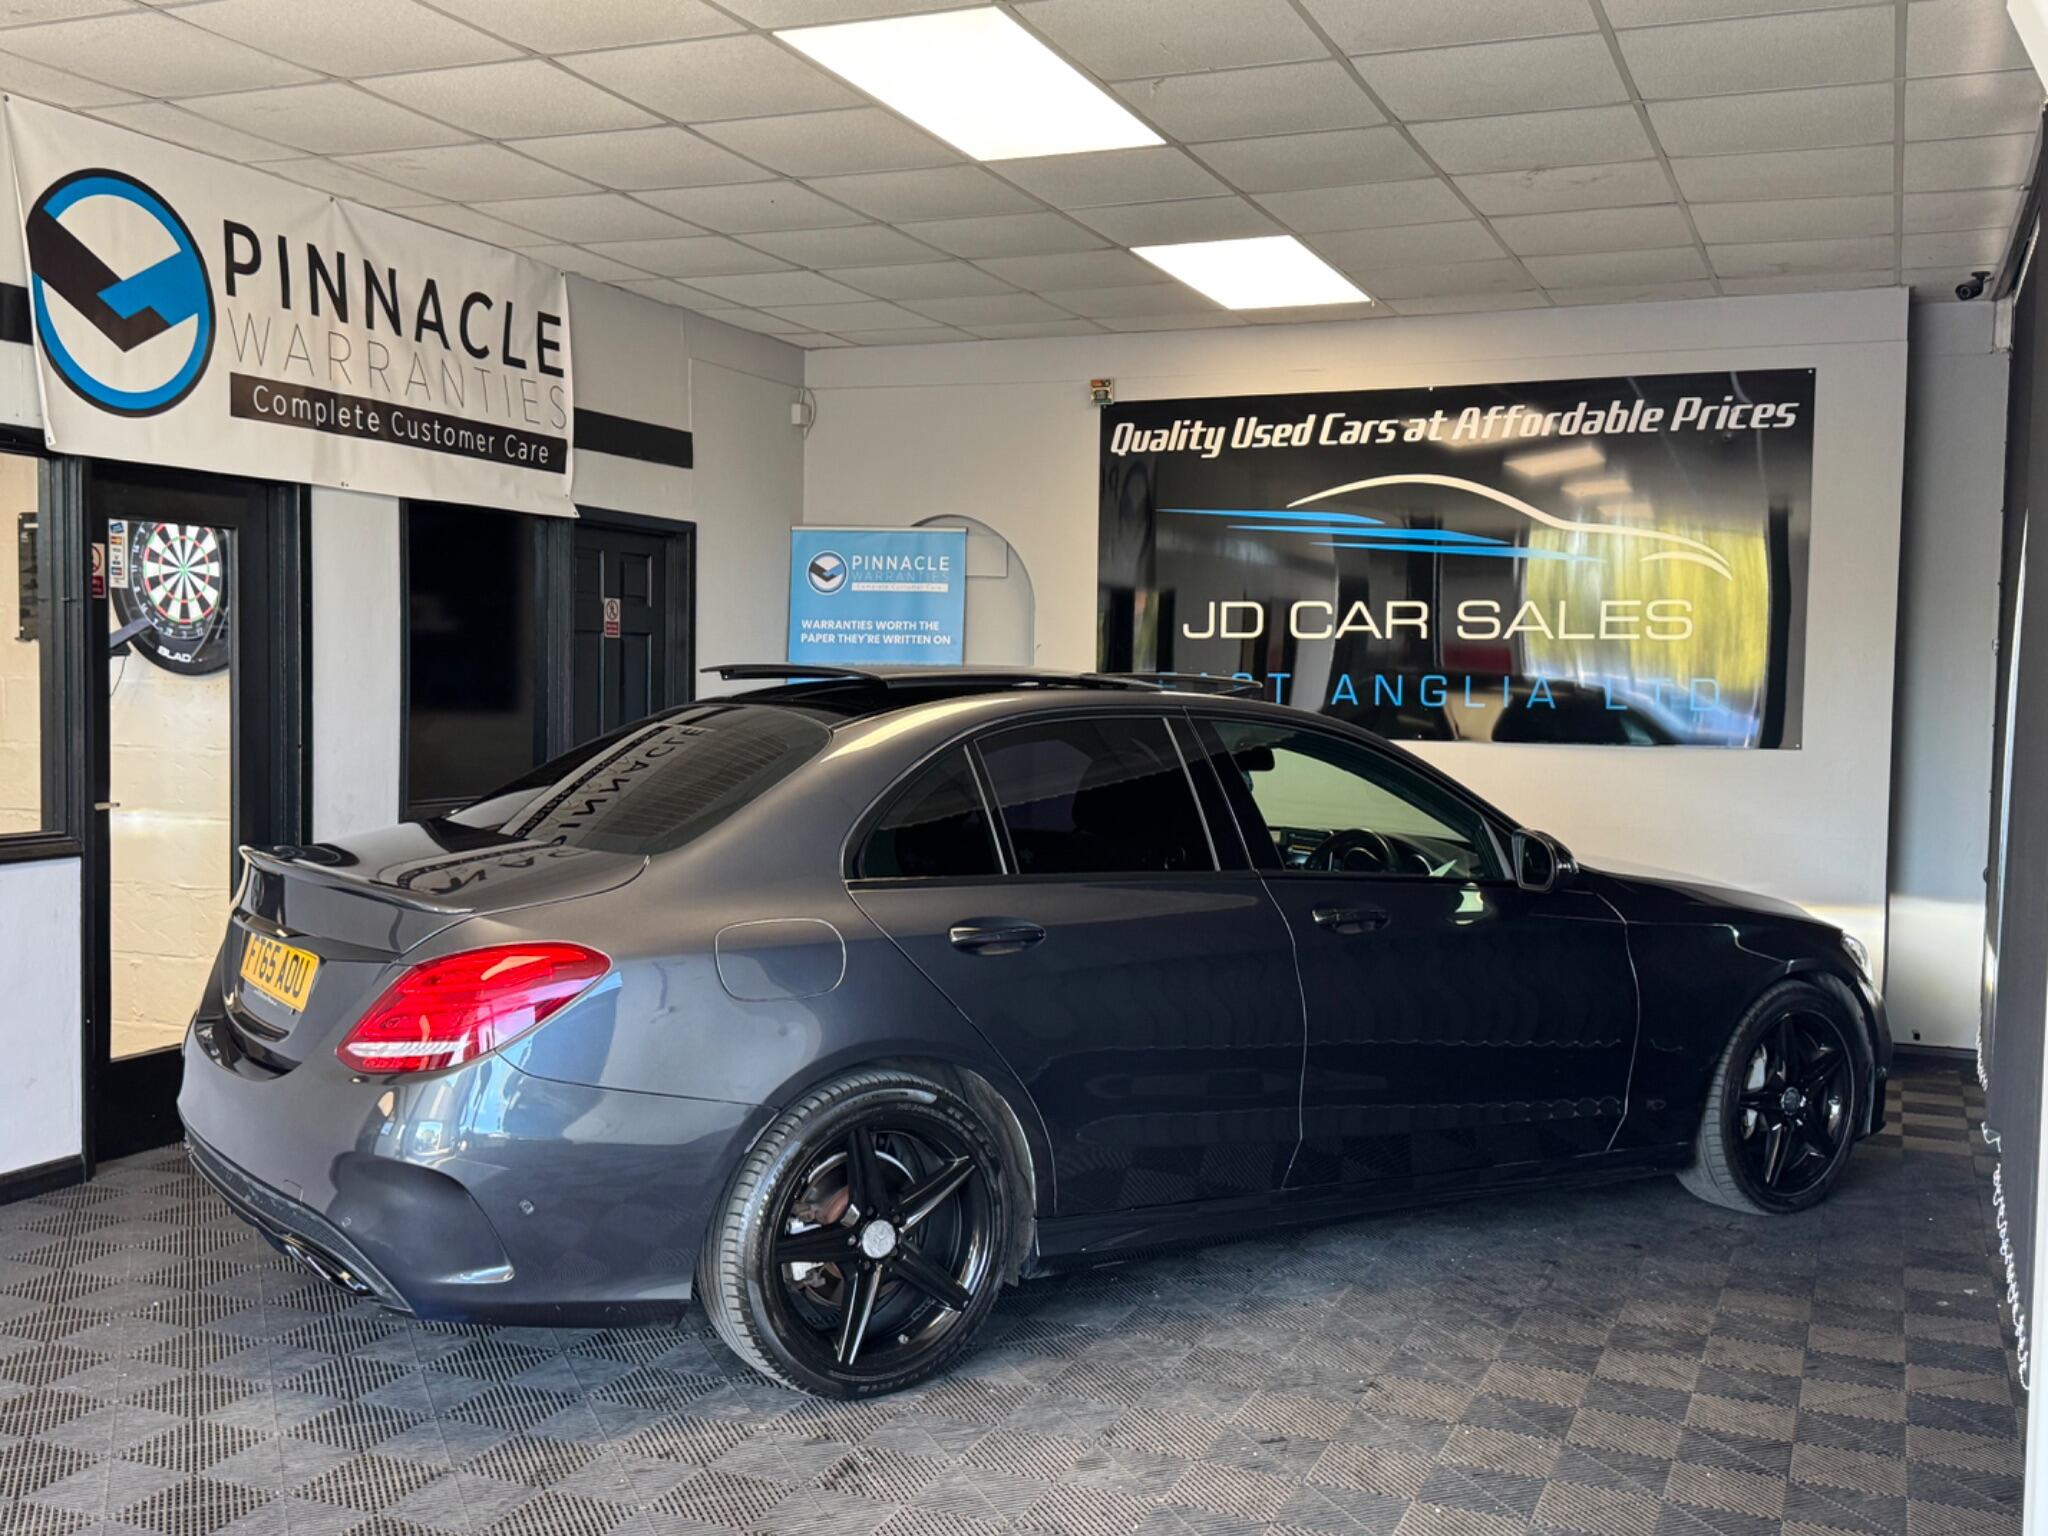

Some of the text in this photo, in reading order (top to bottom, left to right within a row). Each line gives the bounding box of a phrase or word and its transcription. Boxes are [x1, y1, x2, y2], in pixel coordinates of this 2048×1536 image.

[223, 219, 565, 378] PINNACLE
[227, 307, 568, 430] WARRANTIES
[252, 384, 550, 465] Complete Customer Care
[1110, 395, 1800, 459] Quality Used Cars at Affordable Prices
[851, 554, 950, 572] PINNACLE
[801, 619, 940, 631] WARRANTIES WORTH THE
[801, 633, 951, 646] PAPER THEY'RE WRITTEN ON
[1182, 600, 1693, 641] JD CAR SALES
[157, 644, 193, 663] BLAD
[1331, 673, 1556, 709] ANGLIA
[1605, 676, 1720, 711] LTD
[244, 938, 310, 998] FT65 AOU
